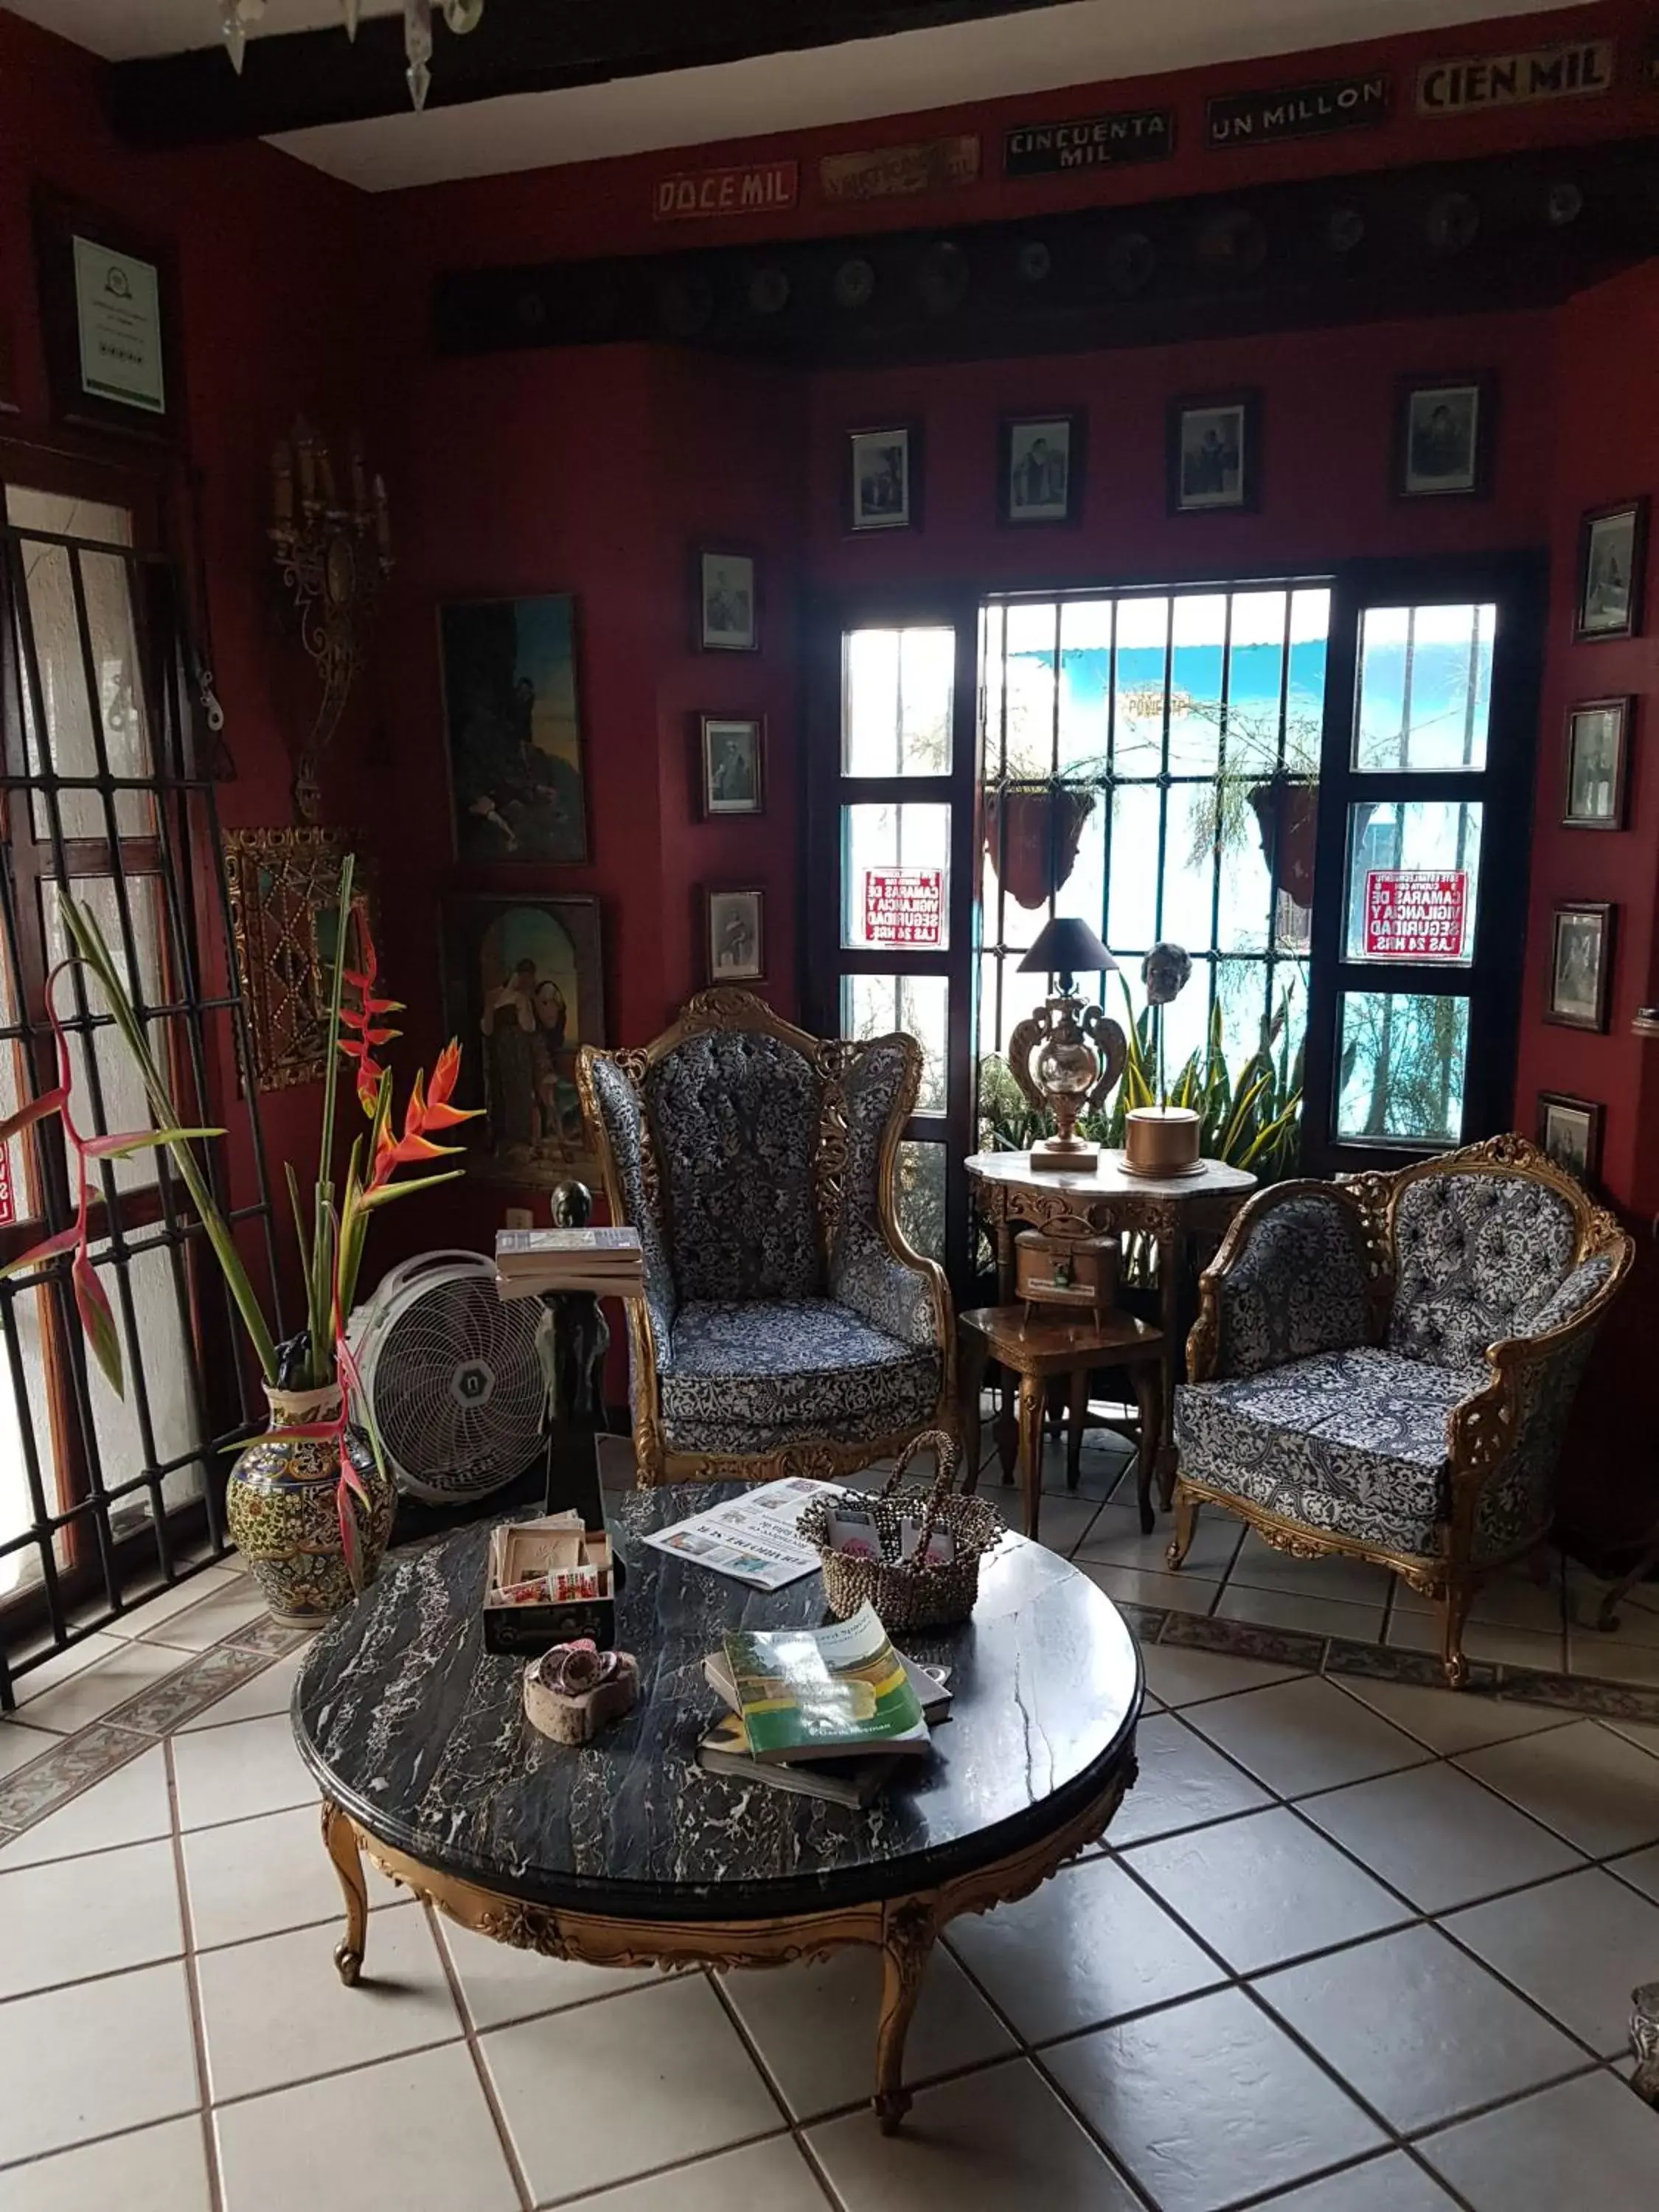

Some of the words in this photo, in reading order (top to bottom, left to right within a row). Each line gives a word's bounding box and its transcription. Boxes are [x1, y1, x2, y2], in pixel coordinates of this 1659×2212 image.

[1423, 58, 1516, 108] CIEN
[1529, 47, 1605, 94] MIL
[1211, 112, 1254, 142] UN
[1262, 78, 1385, 129] MILLON
[1009, 115, 1167, 155] CINCUENTA
[1060, 144, 1111, 169] MIL
[657, 176, 734, 213] DOCE
[740, 169, 790, 207] MIL
